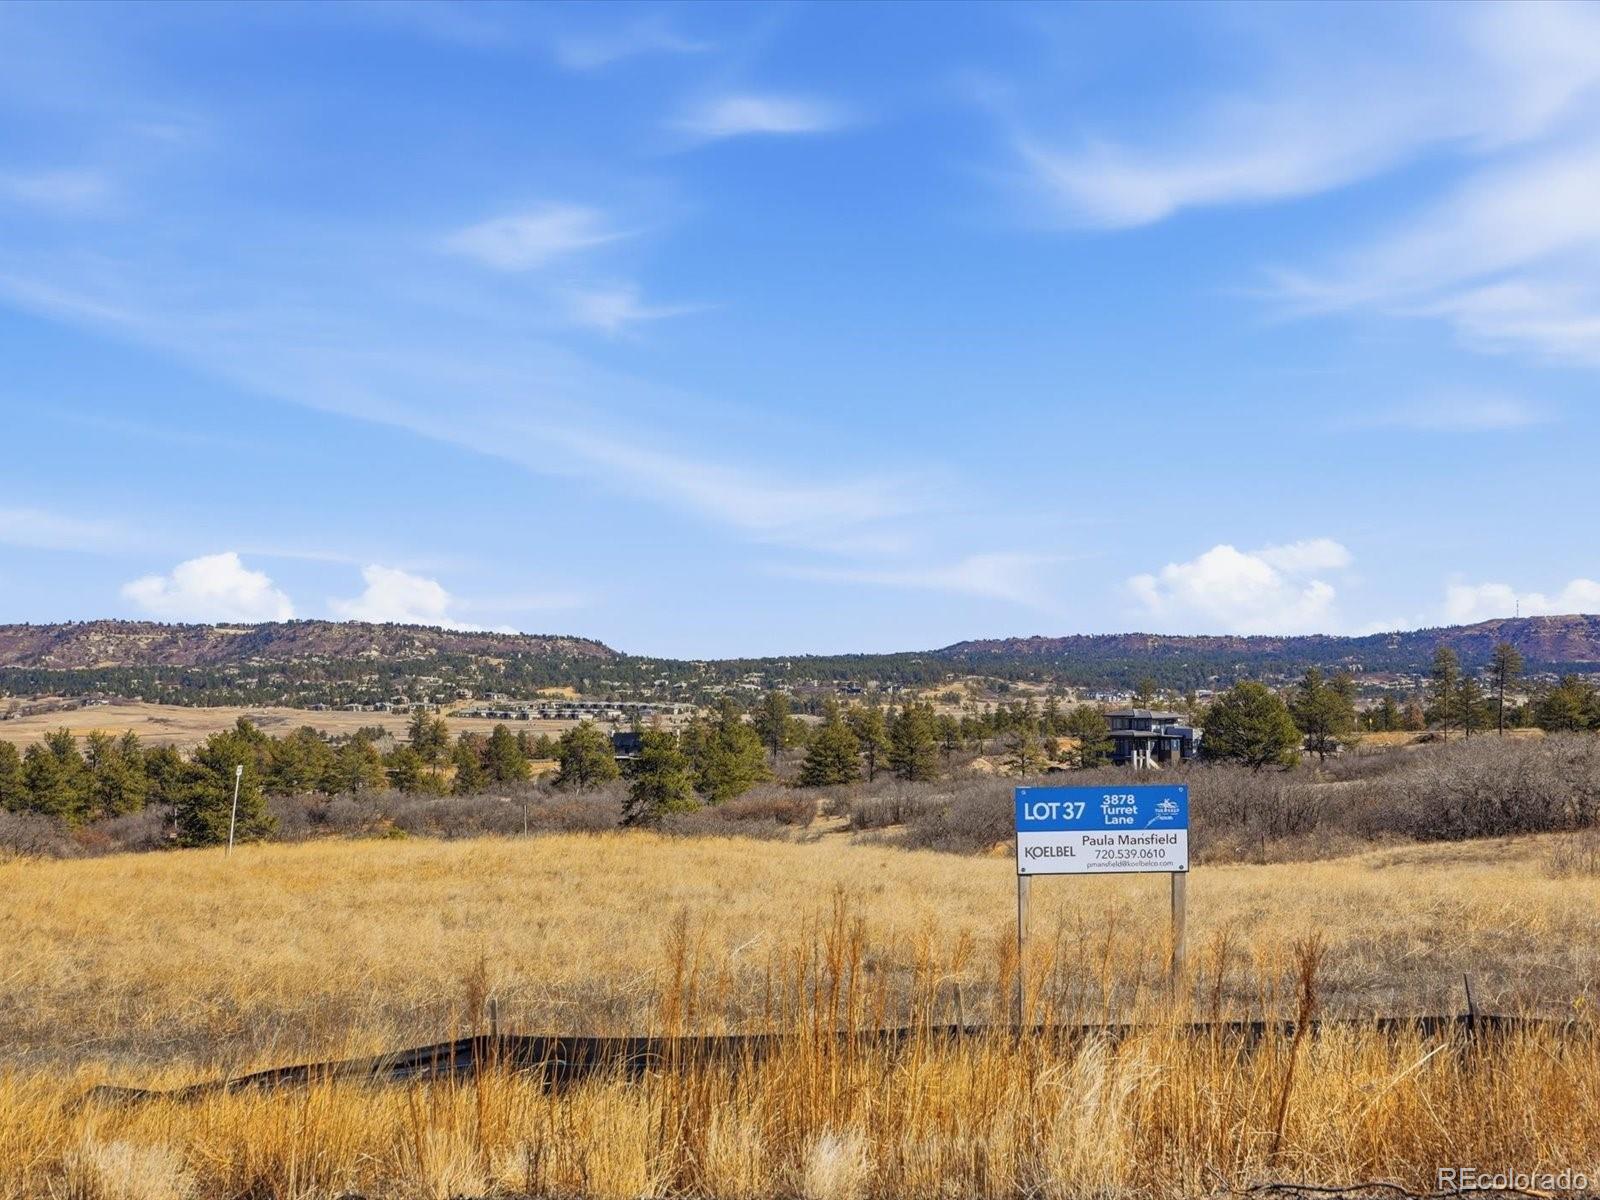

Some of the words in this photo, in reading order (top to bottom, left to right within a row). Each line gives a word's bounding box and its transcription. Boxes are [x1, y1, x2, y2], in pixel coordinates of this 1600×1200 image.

[1103, 794, 1135, 805] 3878
[1024, 803, 1060, 821] LOT
[1062, 802, 1086, 820] 37
[1101, 804, 1138, 815] Turret
[1104, 815, 1134, 825] Lane
[1082, 835, 1115, 846] Paula
[1118, 833, 1178, 845] Mansfield
[1025, 846, 1076, 859] KOELBEL
[1095, 848, 1166, 859] 720.539.0610
